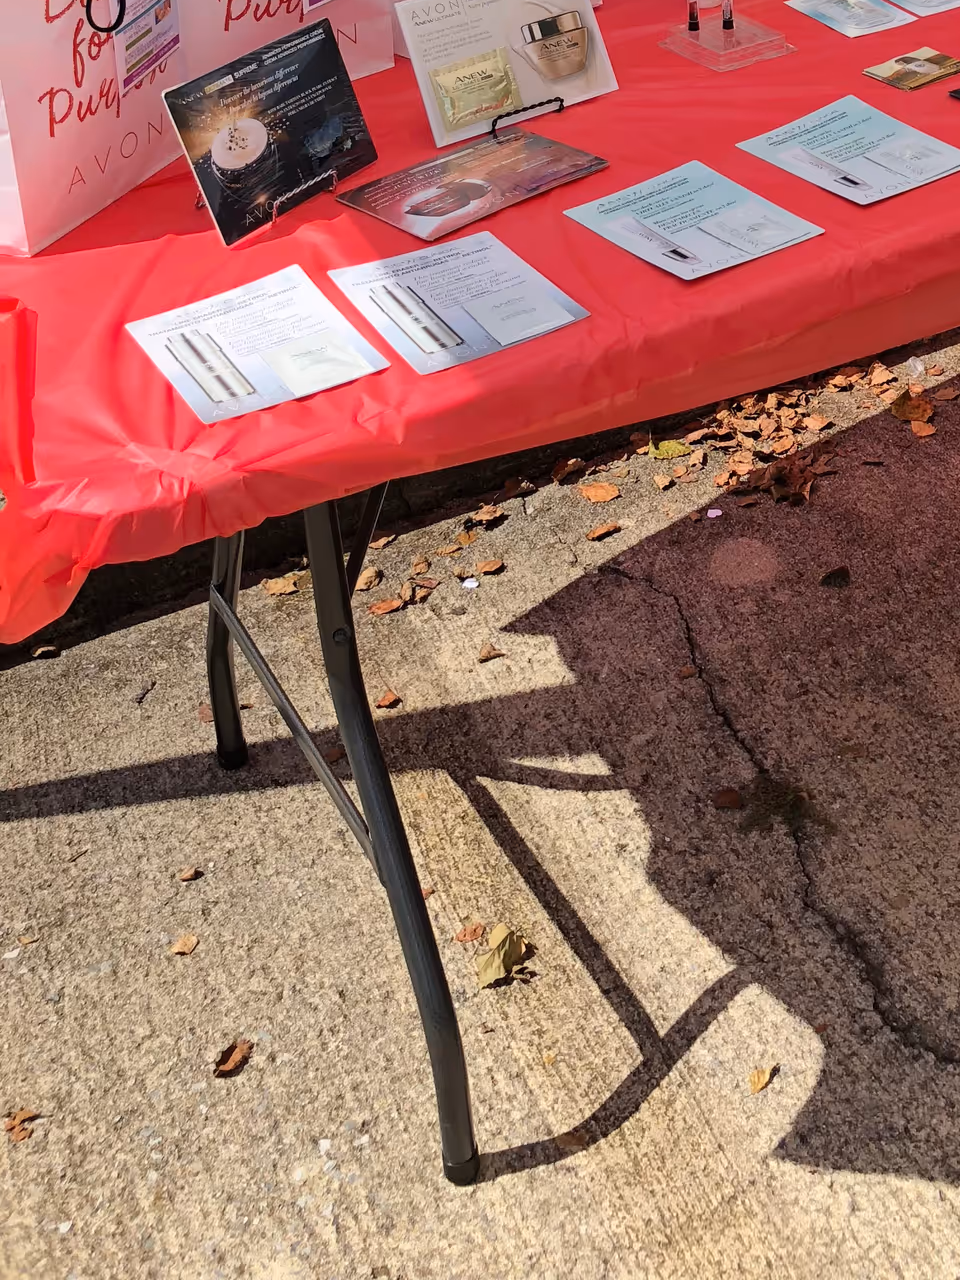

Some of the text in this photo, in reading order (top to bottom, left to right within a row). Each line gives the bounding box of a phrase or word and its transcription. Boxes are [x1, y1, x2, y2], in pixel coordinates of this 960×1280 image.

[413, 17, 434, 26] ANEW
[538, 35, 573, 52] ANEW
[453, 67, 488, 84] ANEW
[68, 112, 163, 195] AVON
